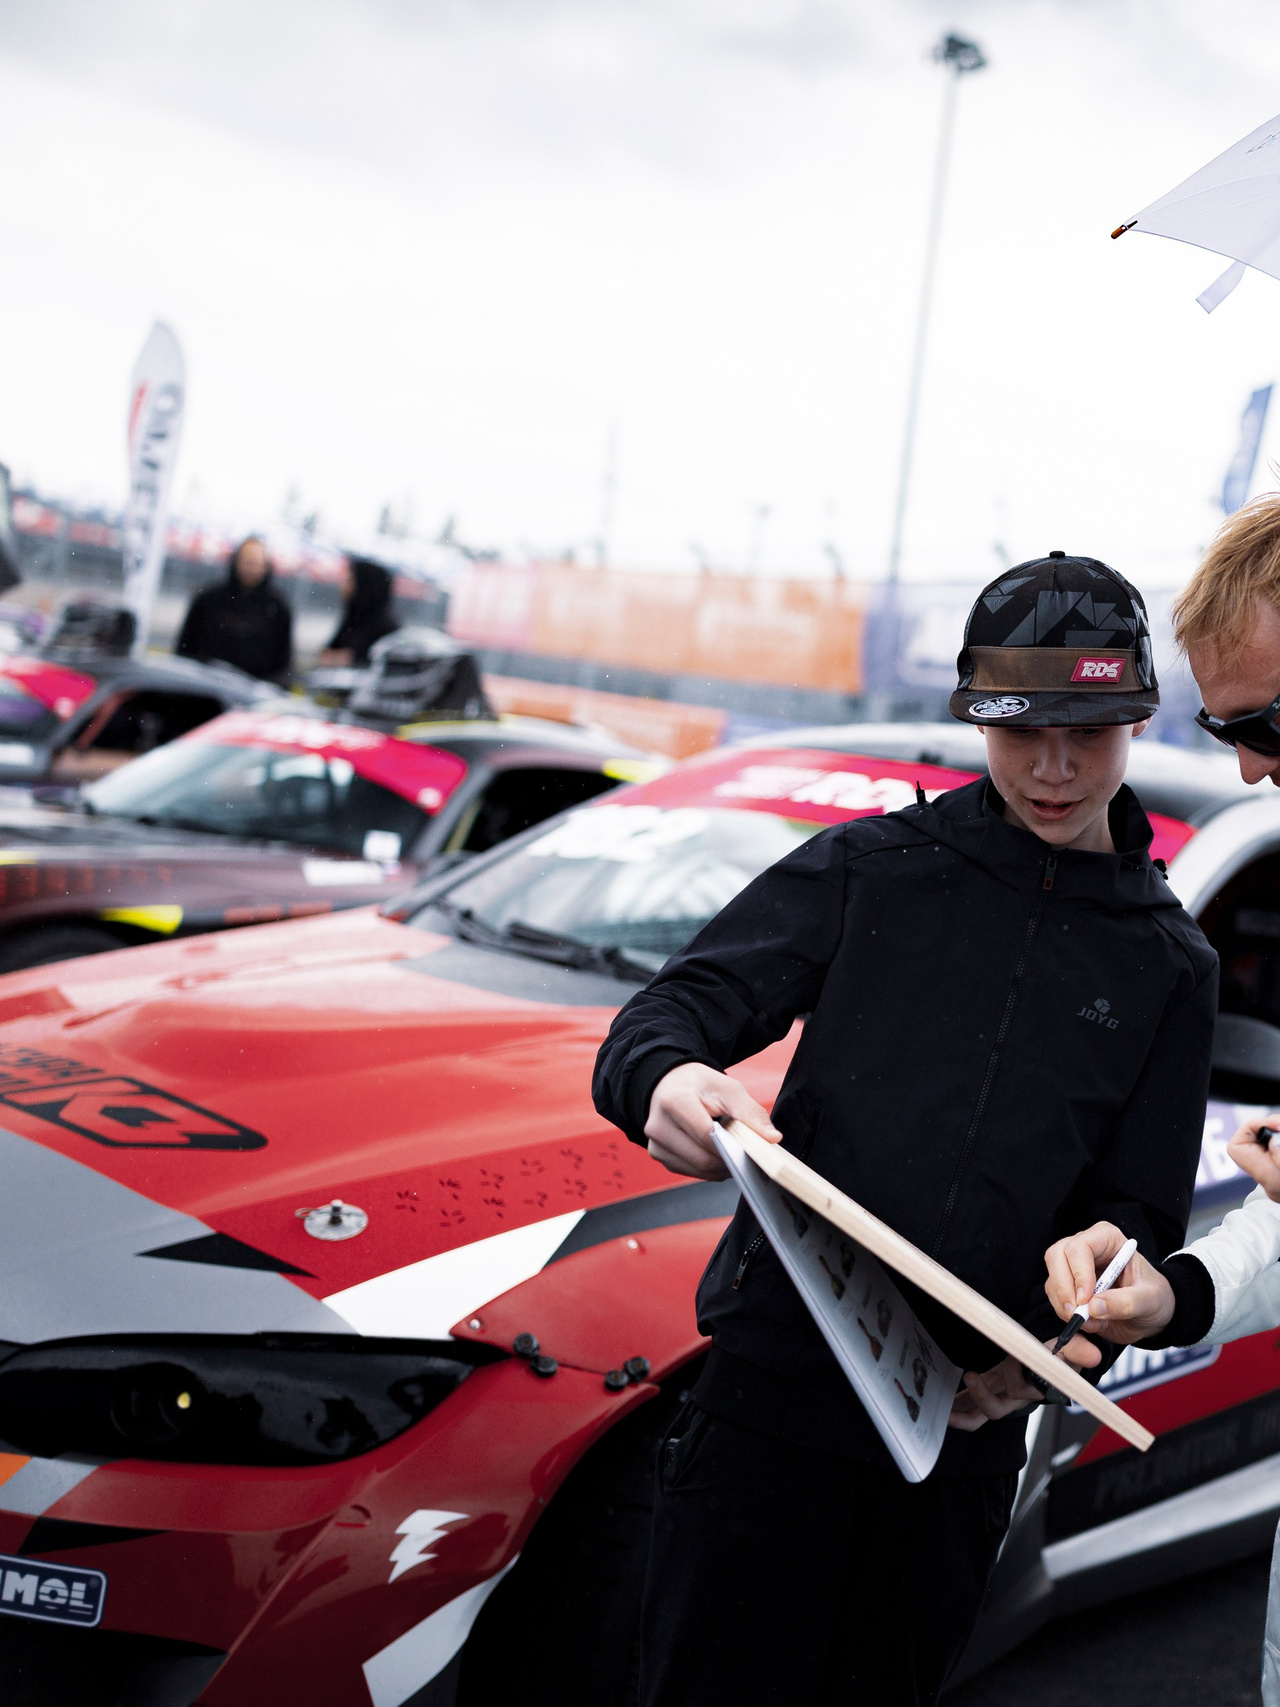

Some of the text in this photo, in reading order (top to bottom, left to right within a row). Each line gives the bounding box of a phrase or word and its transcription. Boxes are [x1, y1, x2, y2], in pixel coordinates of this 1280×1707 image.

[1080, 661, 1121, 678] RDS
[1077, 1007, 1119, 1030] JOYG
[0, 1569, 95, 1614] MOL
